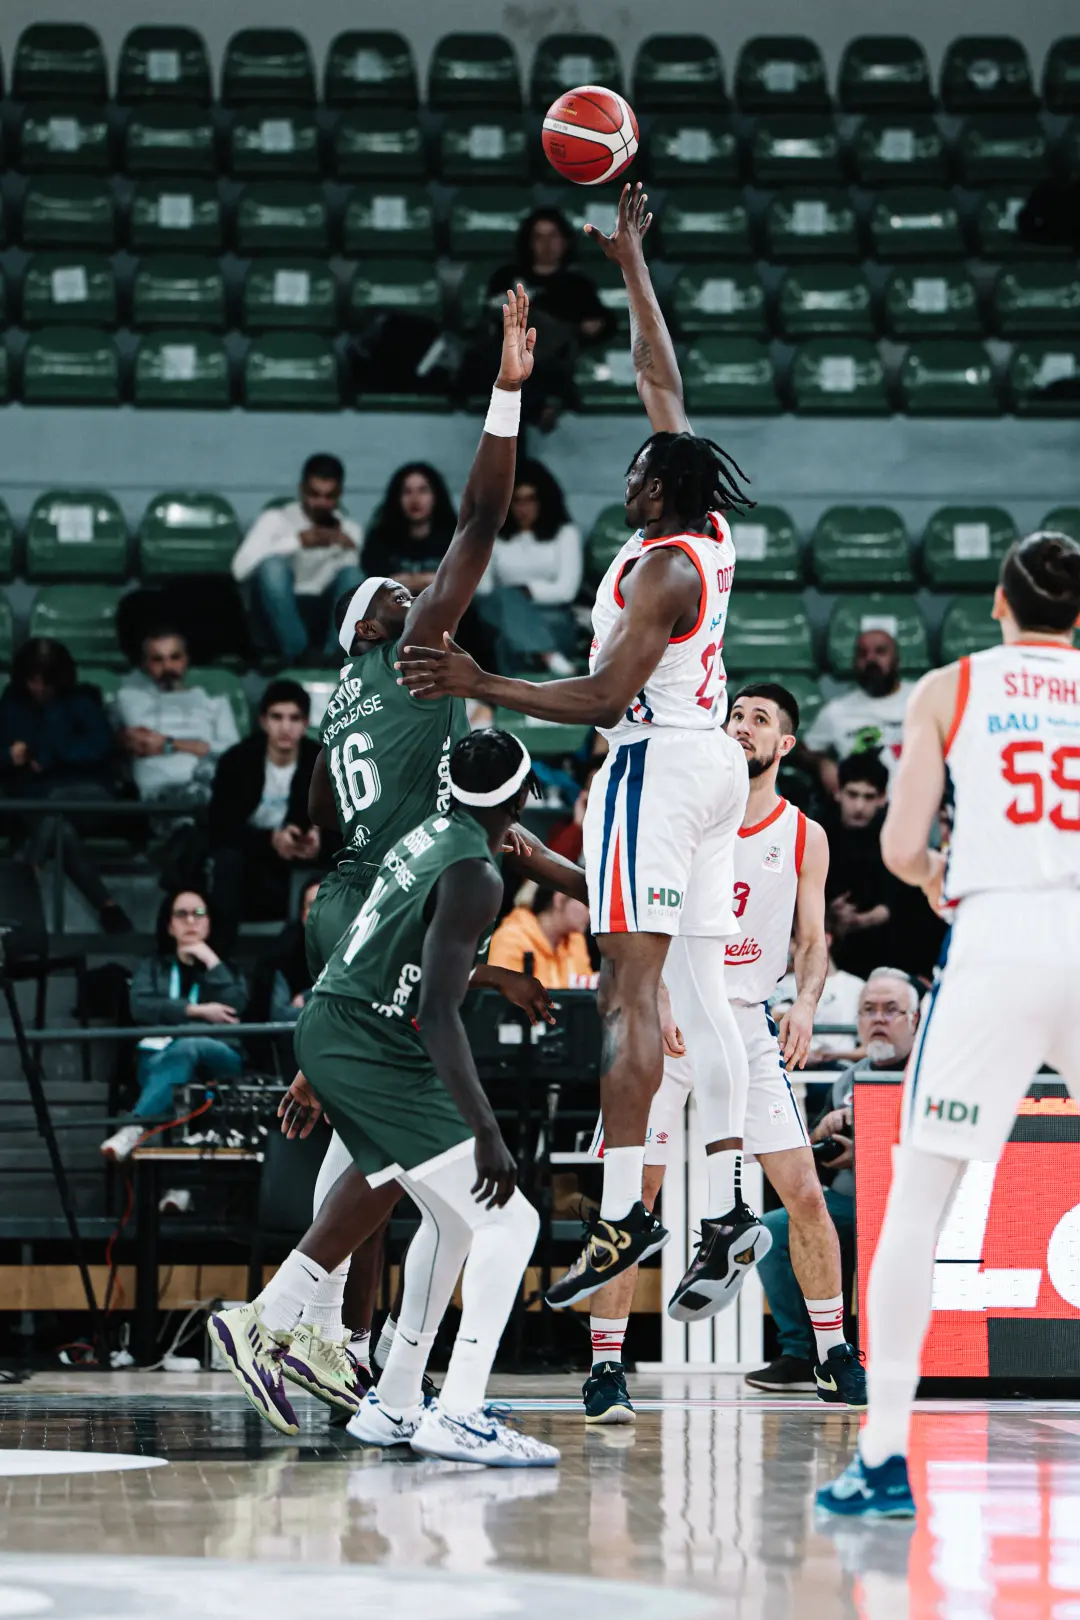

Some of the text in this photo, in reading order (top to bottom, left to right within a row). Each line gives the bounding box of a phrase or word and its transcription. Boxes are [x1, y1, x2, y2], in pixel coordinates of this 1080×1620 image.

[1004, 667, 1080, 705] SİPAH
[987, 712, 1039, 733] BAU
[330, 730, 382, 823] 16
[925, 1096, 979, 1126] HDI
